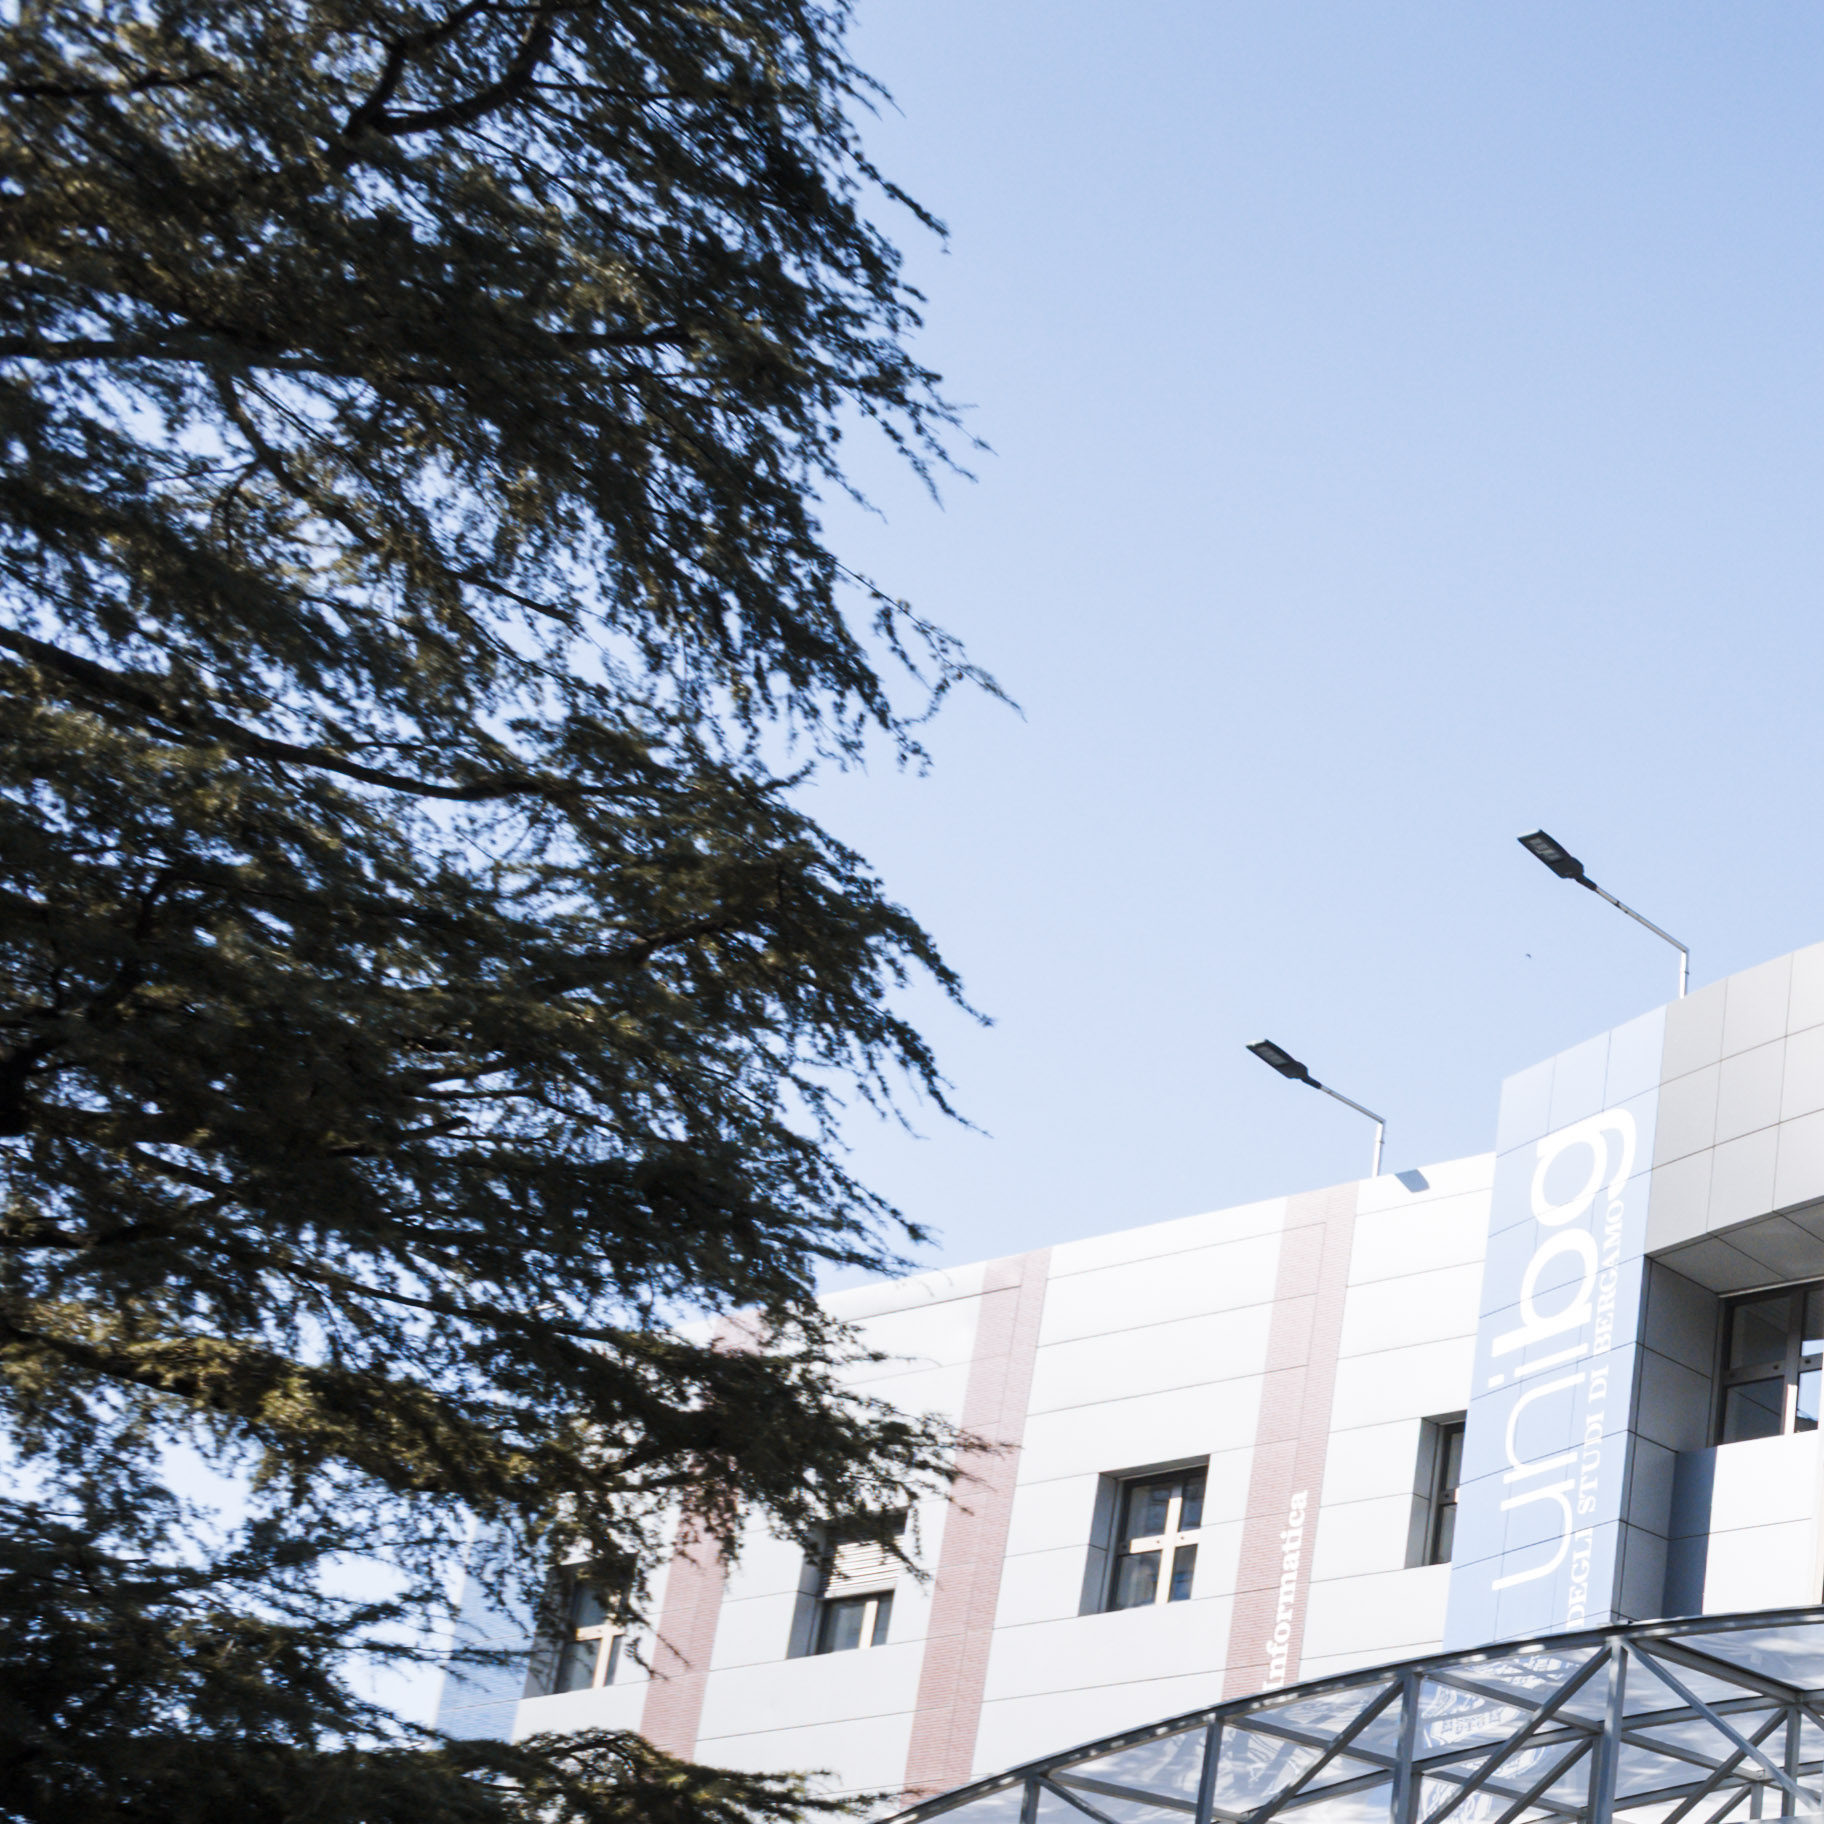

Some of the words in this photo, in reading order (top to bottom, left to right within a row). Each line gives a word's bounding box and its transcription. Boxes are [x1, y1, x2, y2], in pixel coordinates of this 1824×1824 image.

[1593, 1199, 1625, 1357] BERGAMO
[1488, 1107, 1637, 1591] unibg
[1588, 1363, 1610, 1405] DI
[1577, 1411, 1606, 1515] STUDI
[1262, 1489, 1309, 1692] Informatica
[1566, 1527, 1595, 1630] DEGLI
